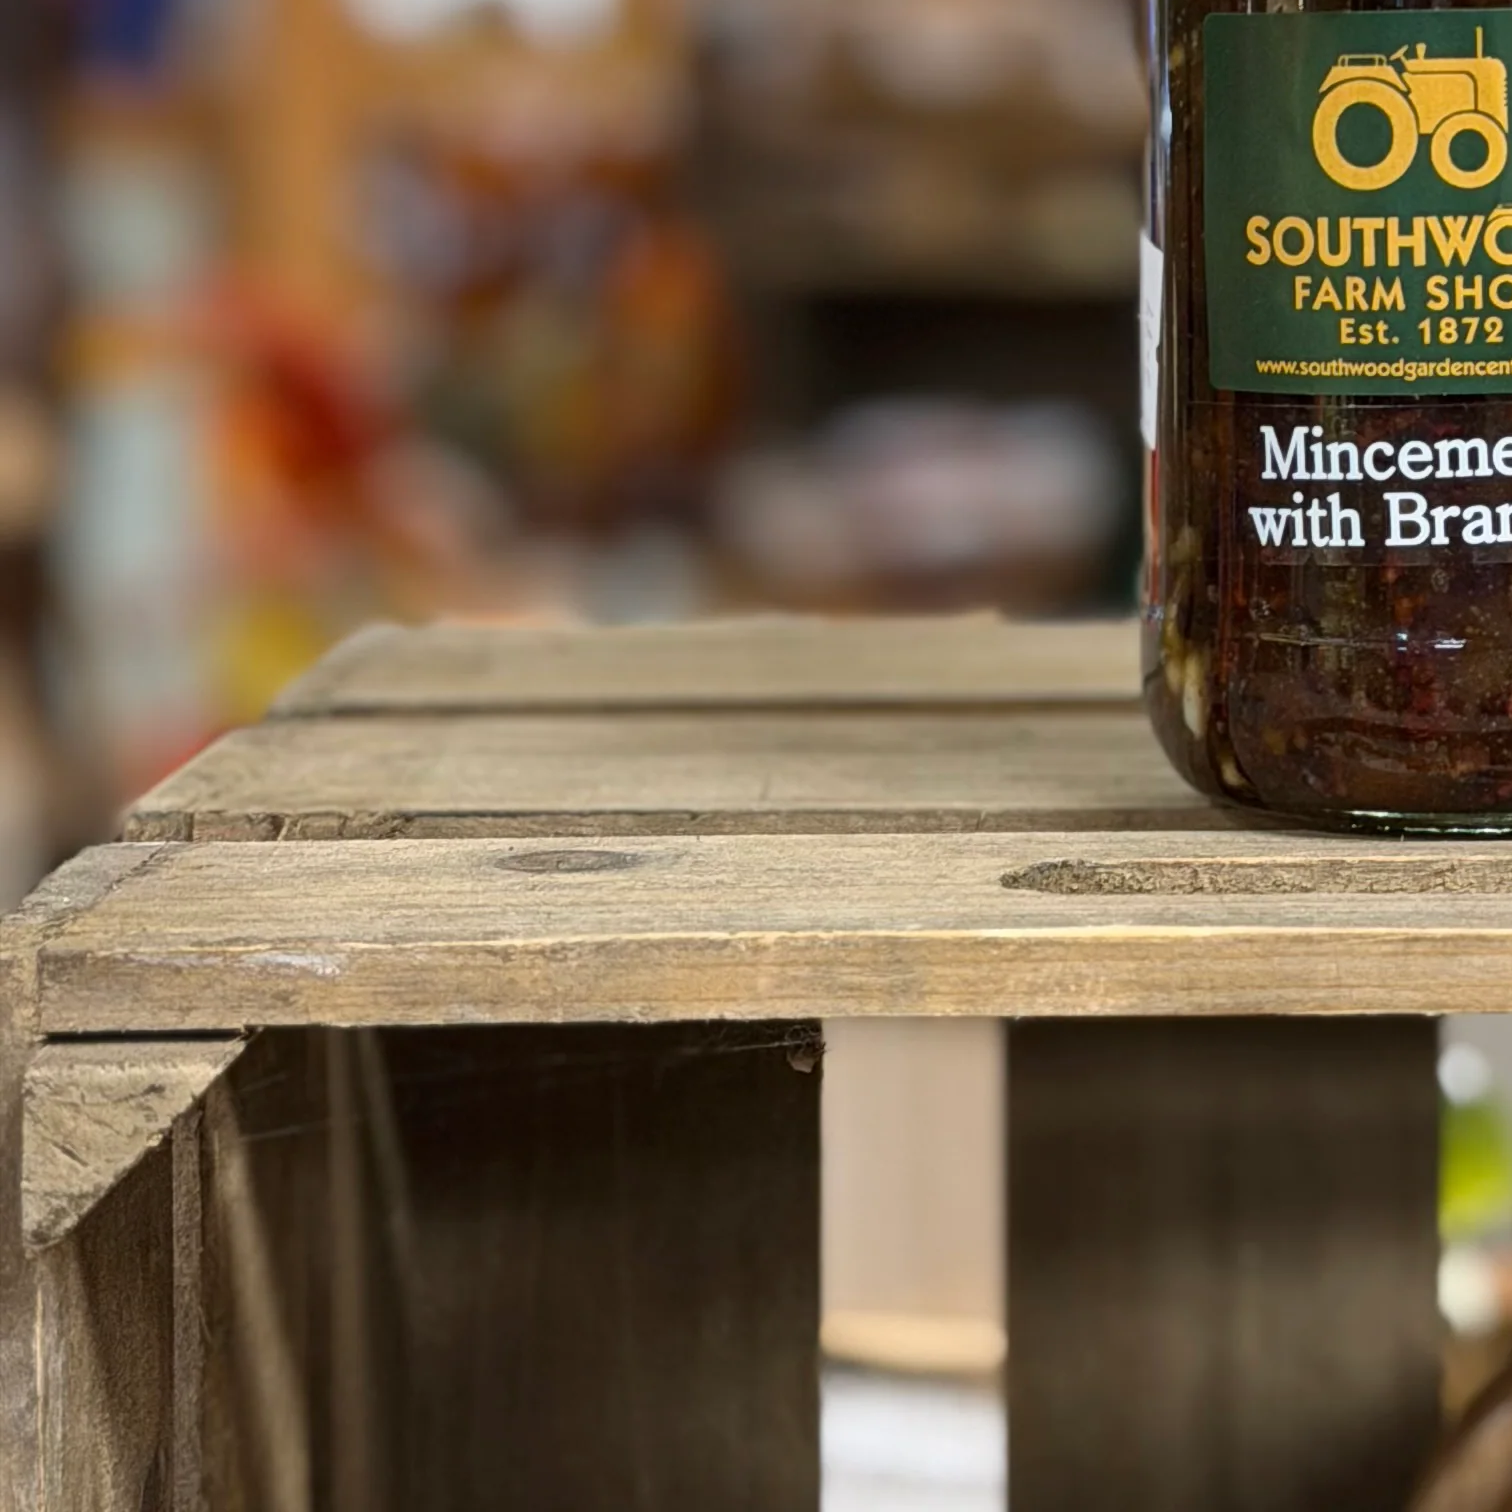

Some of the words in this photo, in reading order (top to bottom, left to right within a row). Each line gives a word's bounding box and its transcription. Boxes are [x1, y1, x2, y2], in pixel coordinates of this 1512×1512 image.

[1294, 275, 1406, 312] FARM
[1339, 318, 1400, 345] Est.
[1418, 317, 1505, 345] 1872
[1248, 491, 1364, 547] with
